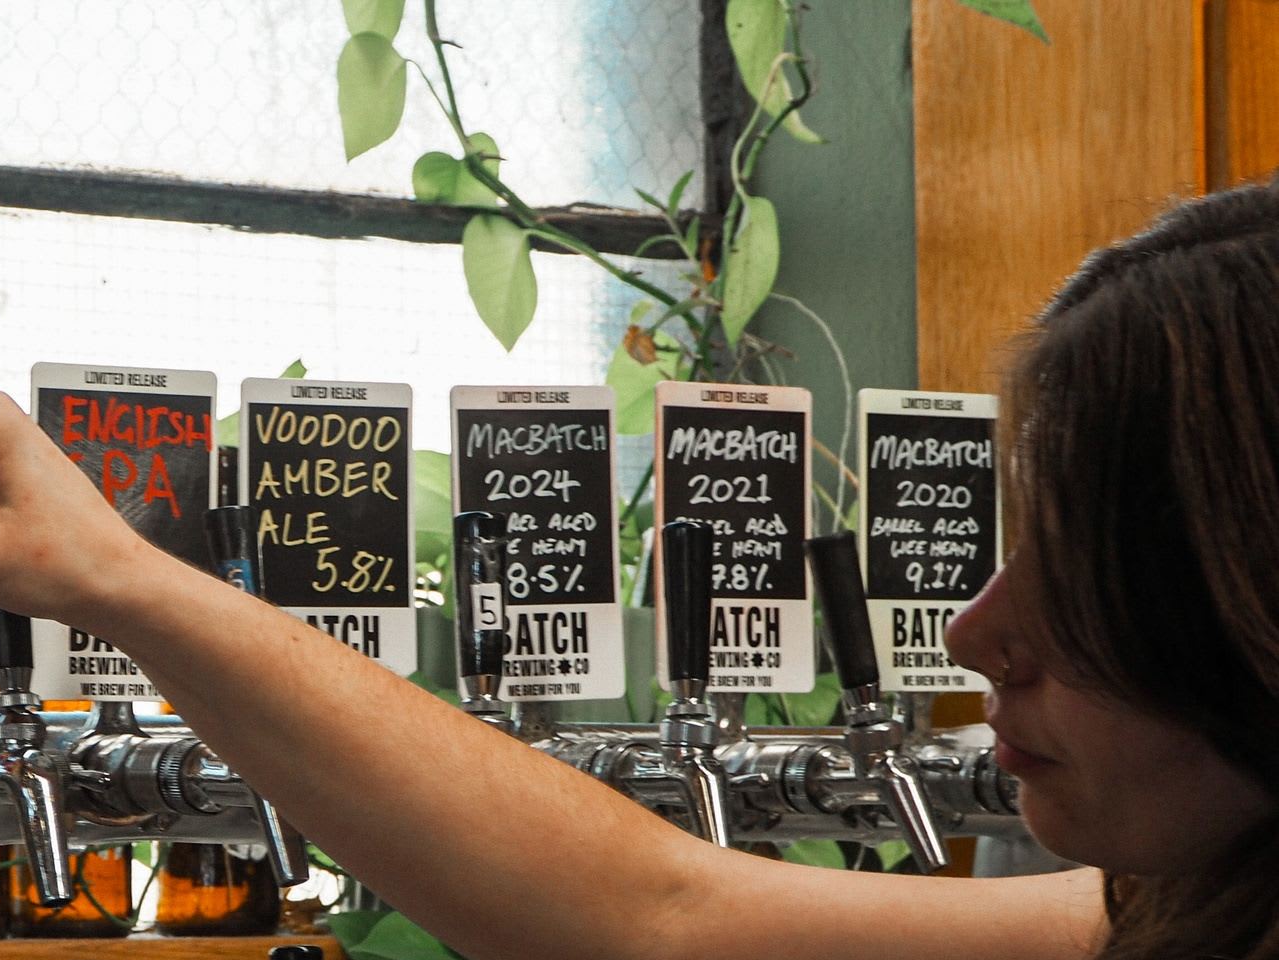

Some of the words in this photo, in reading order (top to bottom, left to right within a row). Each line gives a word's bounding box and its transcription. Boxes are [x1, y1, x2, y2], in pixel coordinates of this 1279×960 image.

[85, 371, 124, 385] LIMITED
[128, 373, 168, 388] RELEASE
[291, 386, 326, 399] LIMITED
[330, 387, 367, 400] RELEASE
[497, 391, 532, 403] LIMITED
[535, 391, 570, 403] RELEASE
[701, 390, 734, 403] LIMITED
[736, 391, 769, 404] RELEASE
[901, 398, 931, 410] LIMITED
[933, 399, 964, 411] RELEASE
[61, 395, 212, 452] ENGLISH
[256, 406, 401, 452] VOODOO
[467, 423, 609, 459] MACBATCH
[667, 426, 798, 465] MACBATCH
[870, 435, 993, 470] MACBATCH
[256, 459, 398, 500] AMBER
[484, 469, 581, 503] 2024
[688, 473, 773, 504] 2021
[896, 480, 972, 509] 2020
[259, 509, 330, 545] ALE
[548, 511, 597, 532] AGED
[932, 516, 980, 537] AGED
[732, 540, 782, 560] HEAVY
[312, 546, 396, 593] 5.8%
[507, 562, 585, 598] 8.5%
[479, 595, 497, 625] 5
[711, 606, 780, 648] ATCH
[69, 656, 137, 675] BREWING
[504, 659, 555, 676] REWING
[574, 658, 589, 675] CO
[766, 652, 780, 668] CO
[893, 652, 943, 668] BREWING
[80, 683, 96, 696] WE
[98, 683, 125, 696] BREW
[128, 684, 144, 696] FOR
[508, 684, 521, 697] WE
[523, 684, 545, 696] BREW
[548, 684, 562, 695] FOR
[566, 683, 580, 695] YOU
[718, 675, 738, 687] BREW
[742, 675, 755, 687] FOR
[758, 676, 772, 687] YOU
[903, 675, 914, 686] WE
[916, 675, 935, 686] BREW
[938, 675, 950, 686] FOR
[952, 675, 965, 686] YOU
